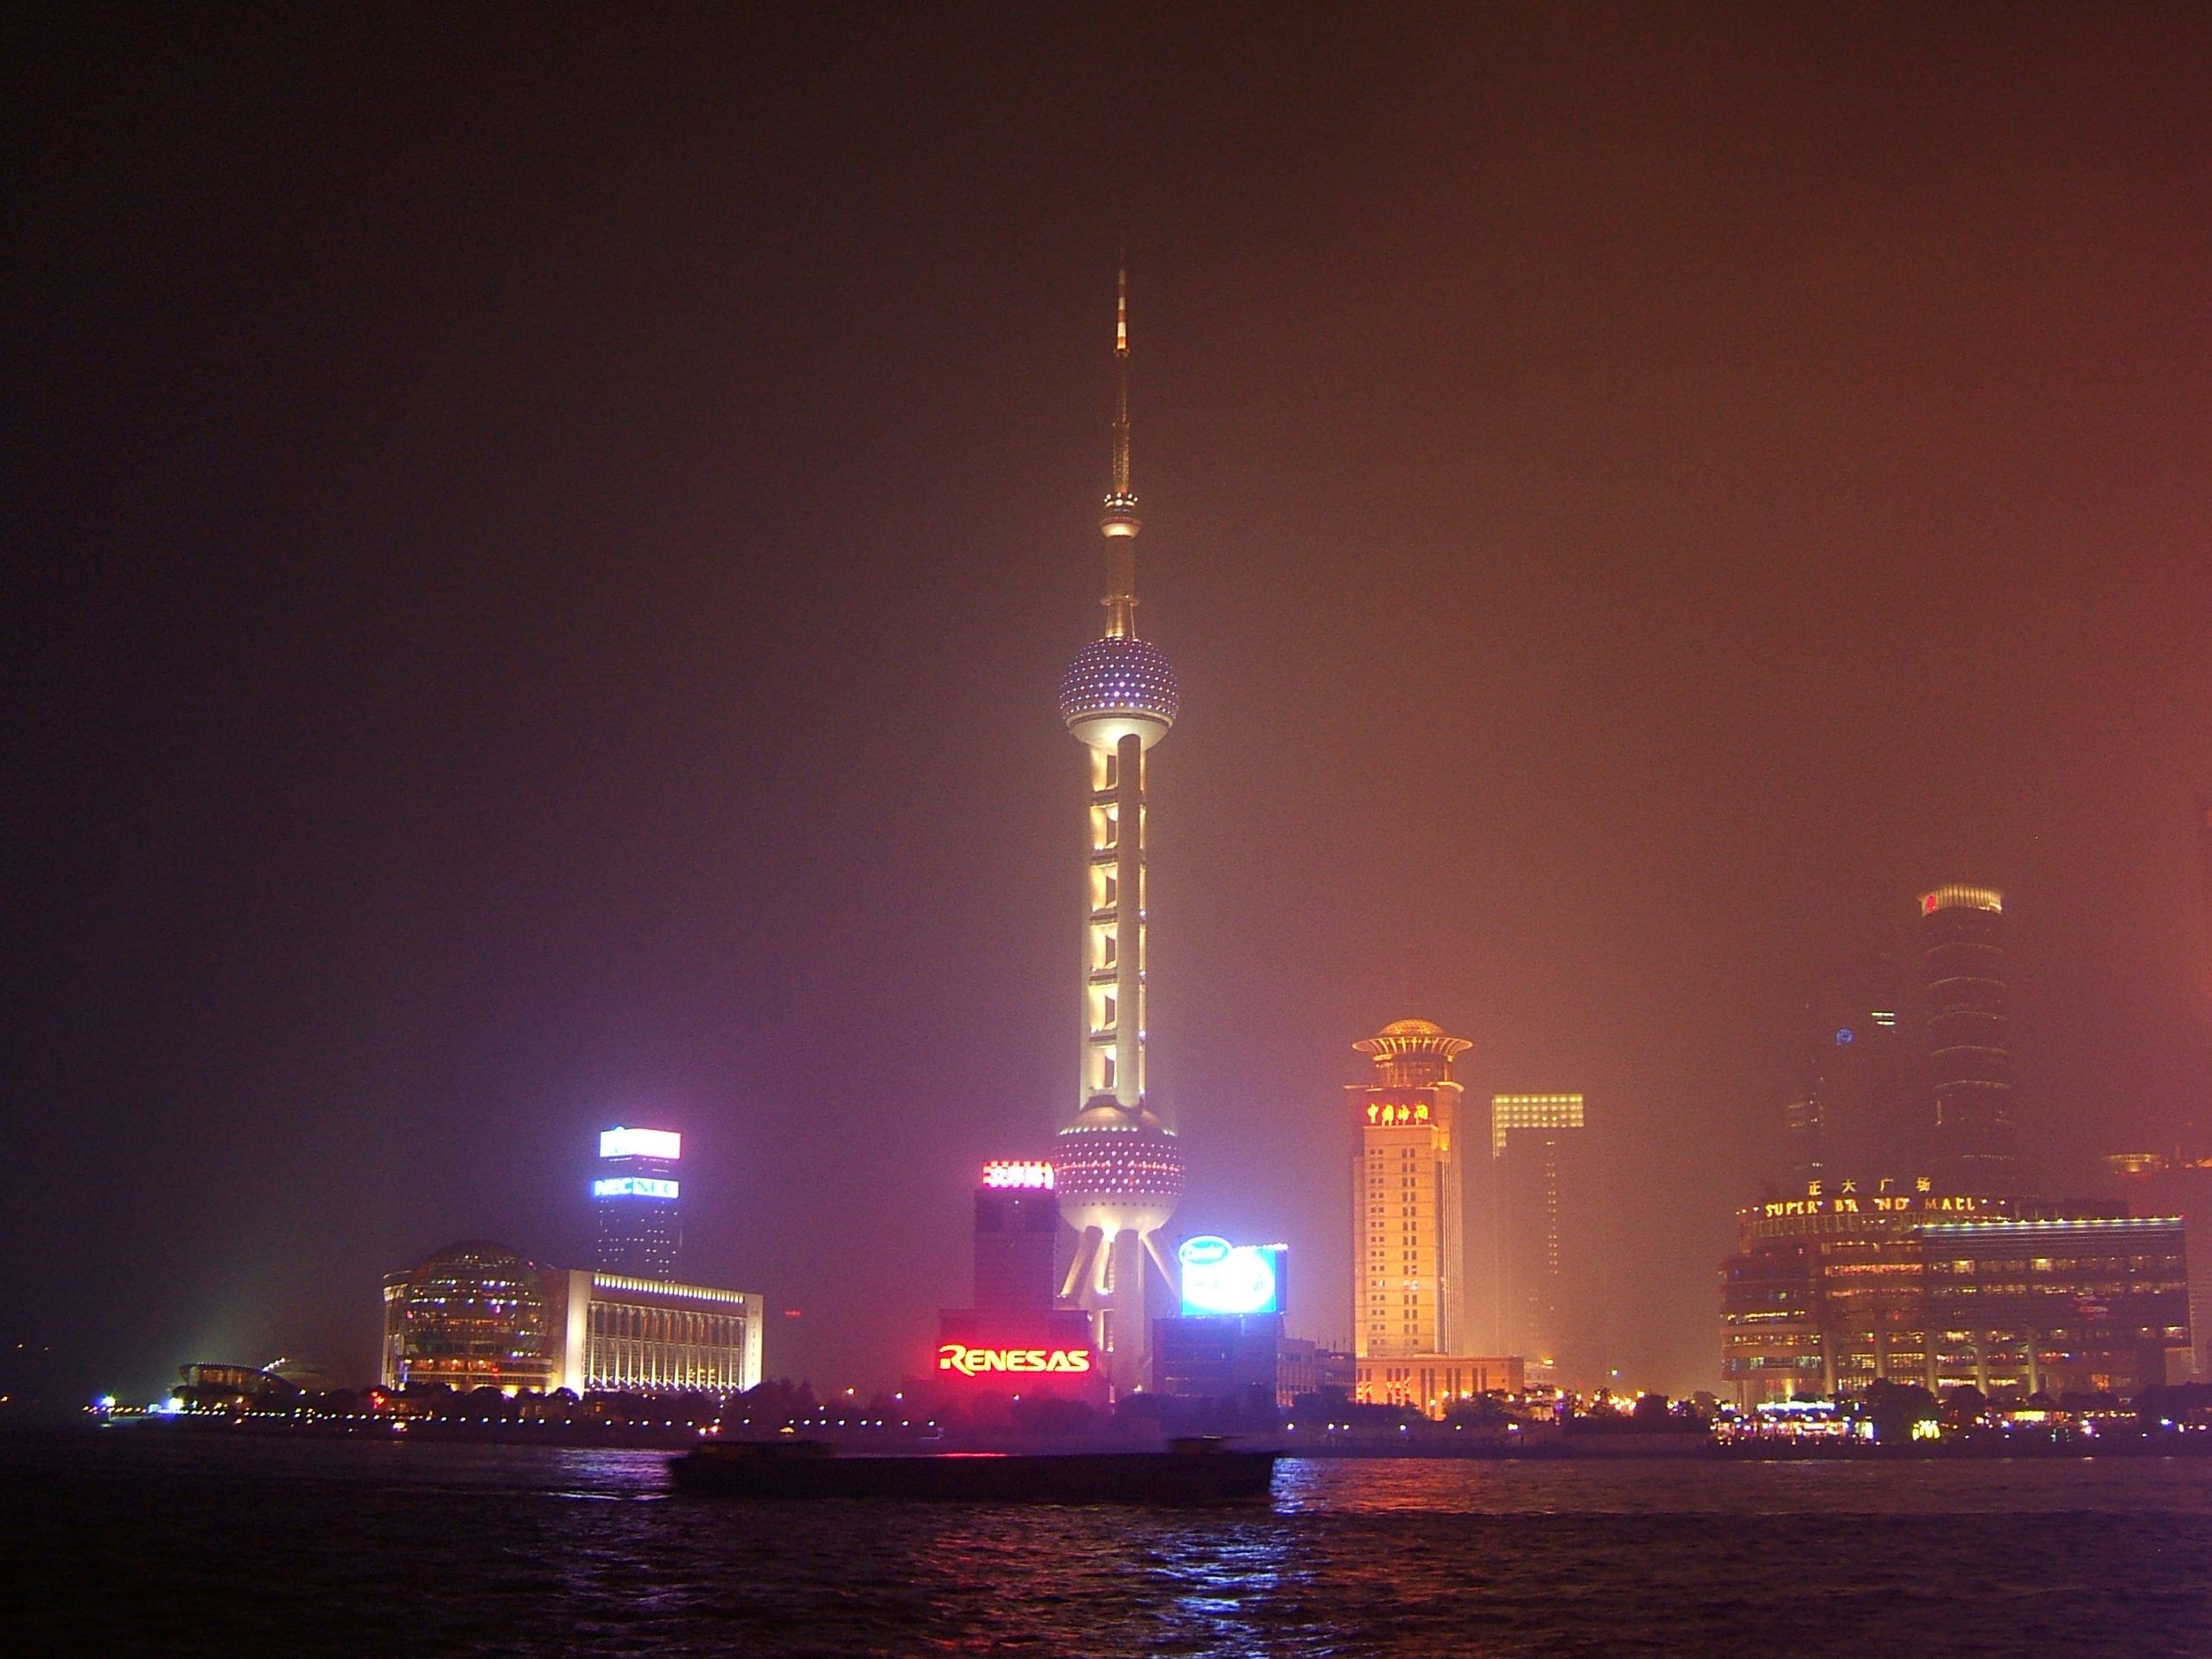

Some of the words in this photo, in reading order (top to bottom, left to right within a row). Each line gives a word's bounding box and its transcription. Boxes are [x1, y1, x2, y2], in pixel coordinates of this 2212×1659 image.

[1765, 1200, 1818, 1217] SUPER
[1834, 1198, 1908, 1212] BRND
[1924, 1197, 1975, 1211] MALL
[938, 1344, 1090, 1376] RENESAS
